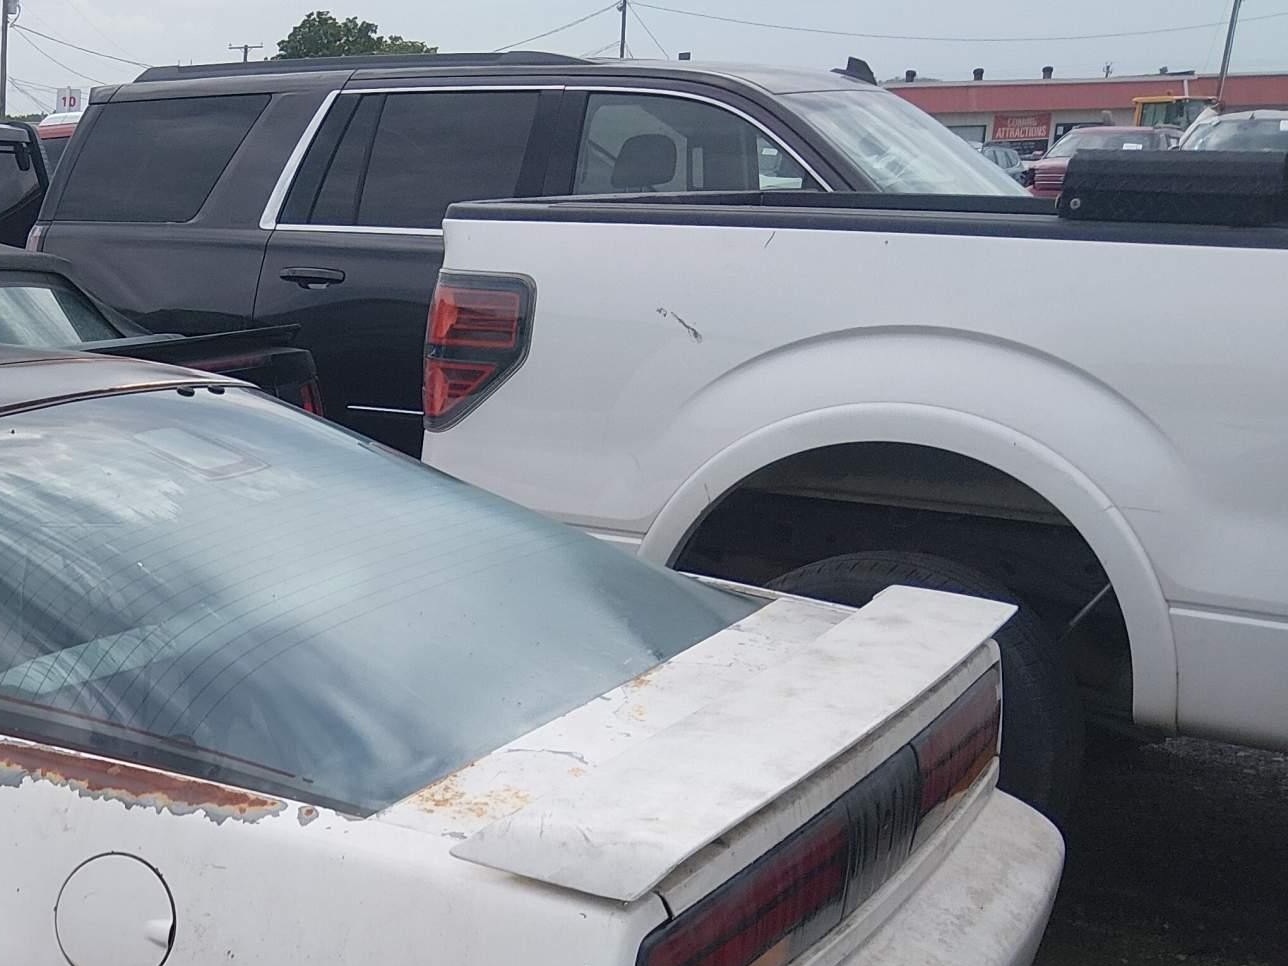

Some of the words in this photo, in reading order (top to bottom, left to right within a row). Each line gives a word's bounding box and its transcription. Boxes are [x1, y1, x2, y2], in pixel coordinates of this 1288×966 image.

[62, 96, 76, 107] 10
[1007, 117, 1038, 128] COMING
[995, 126, 1047, 138] ATTRACTIONS
